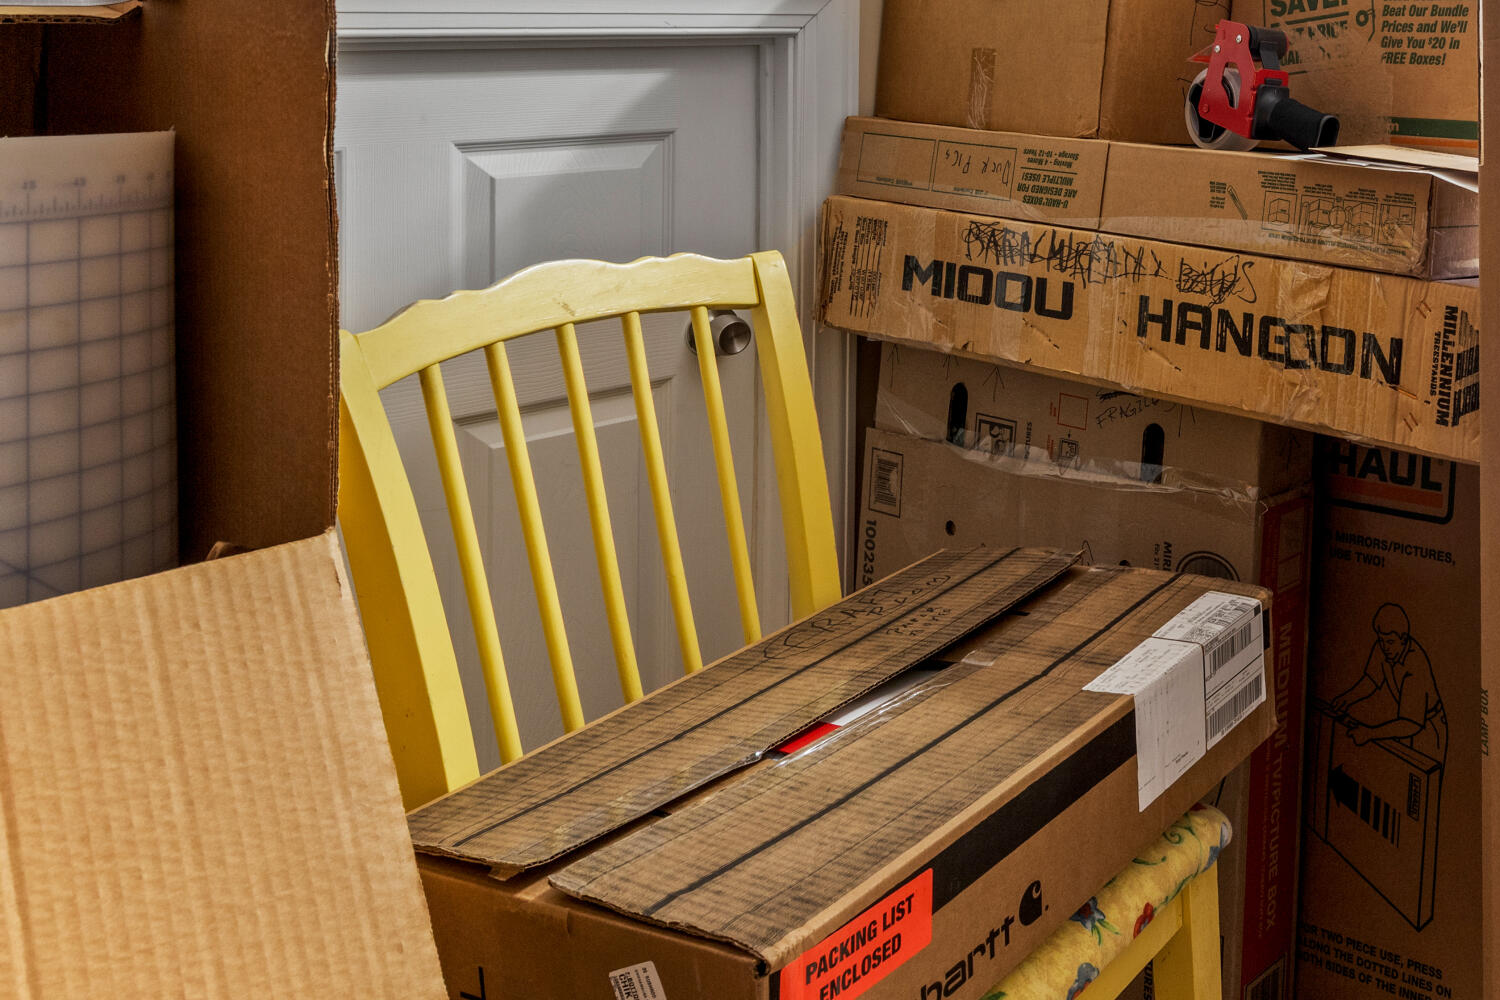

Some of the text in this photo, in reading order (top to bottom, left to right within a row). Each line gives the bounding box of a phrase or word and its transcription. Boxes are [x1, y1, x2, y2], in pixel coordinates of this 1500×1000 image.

[1382, 5, 1469, 17] Beat Our Bundle
[1381, 21, 1468, 33] Prices and We'll
[1381, 37, 1460, 50] Give You $20 in
[1381, 53, 1447, 65] FREE Boxes!
[1016, 182, 1077, 198] ARE DESIGNED FOR
[1021, 171, 1073, 186] MULTIPLE USES!
[1435, 305, 1459, 427] MILLENNIUM
[1356, 551, 1385, 568] TWO!
[1265, 884, 1279, 931] BOX
[806, 893, 915, 986] PACKING LIST
[1321, 928, 1442, 979] TWO PIECE USE, PRESS
[819, 934, 903, 1000] ENCLOSED
[1326, 961, 1396, 995] SIDES OF THE
[1334, 947, 1452, 999] THE DOTTED LINES ON
